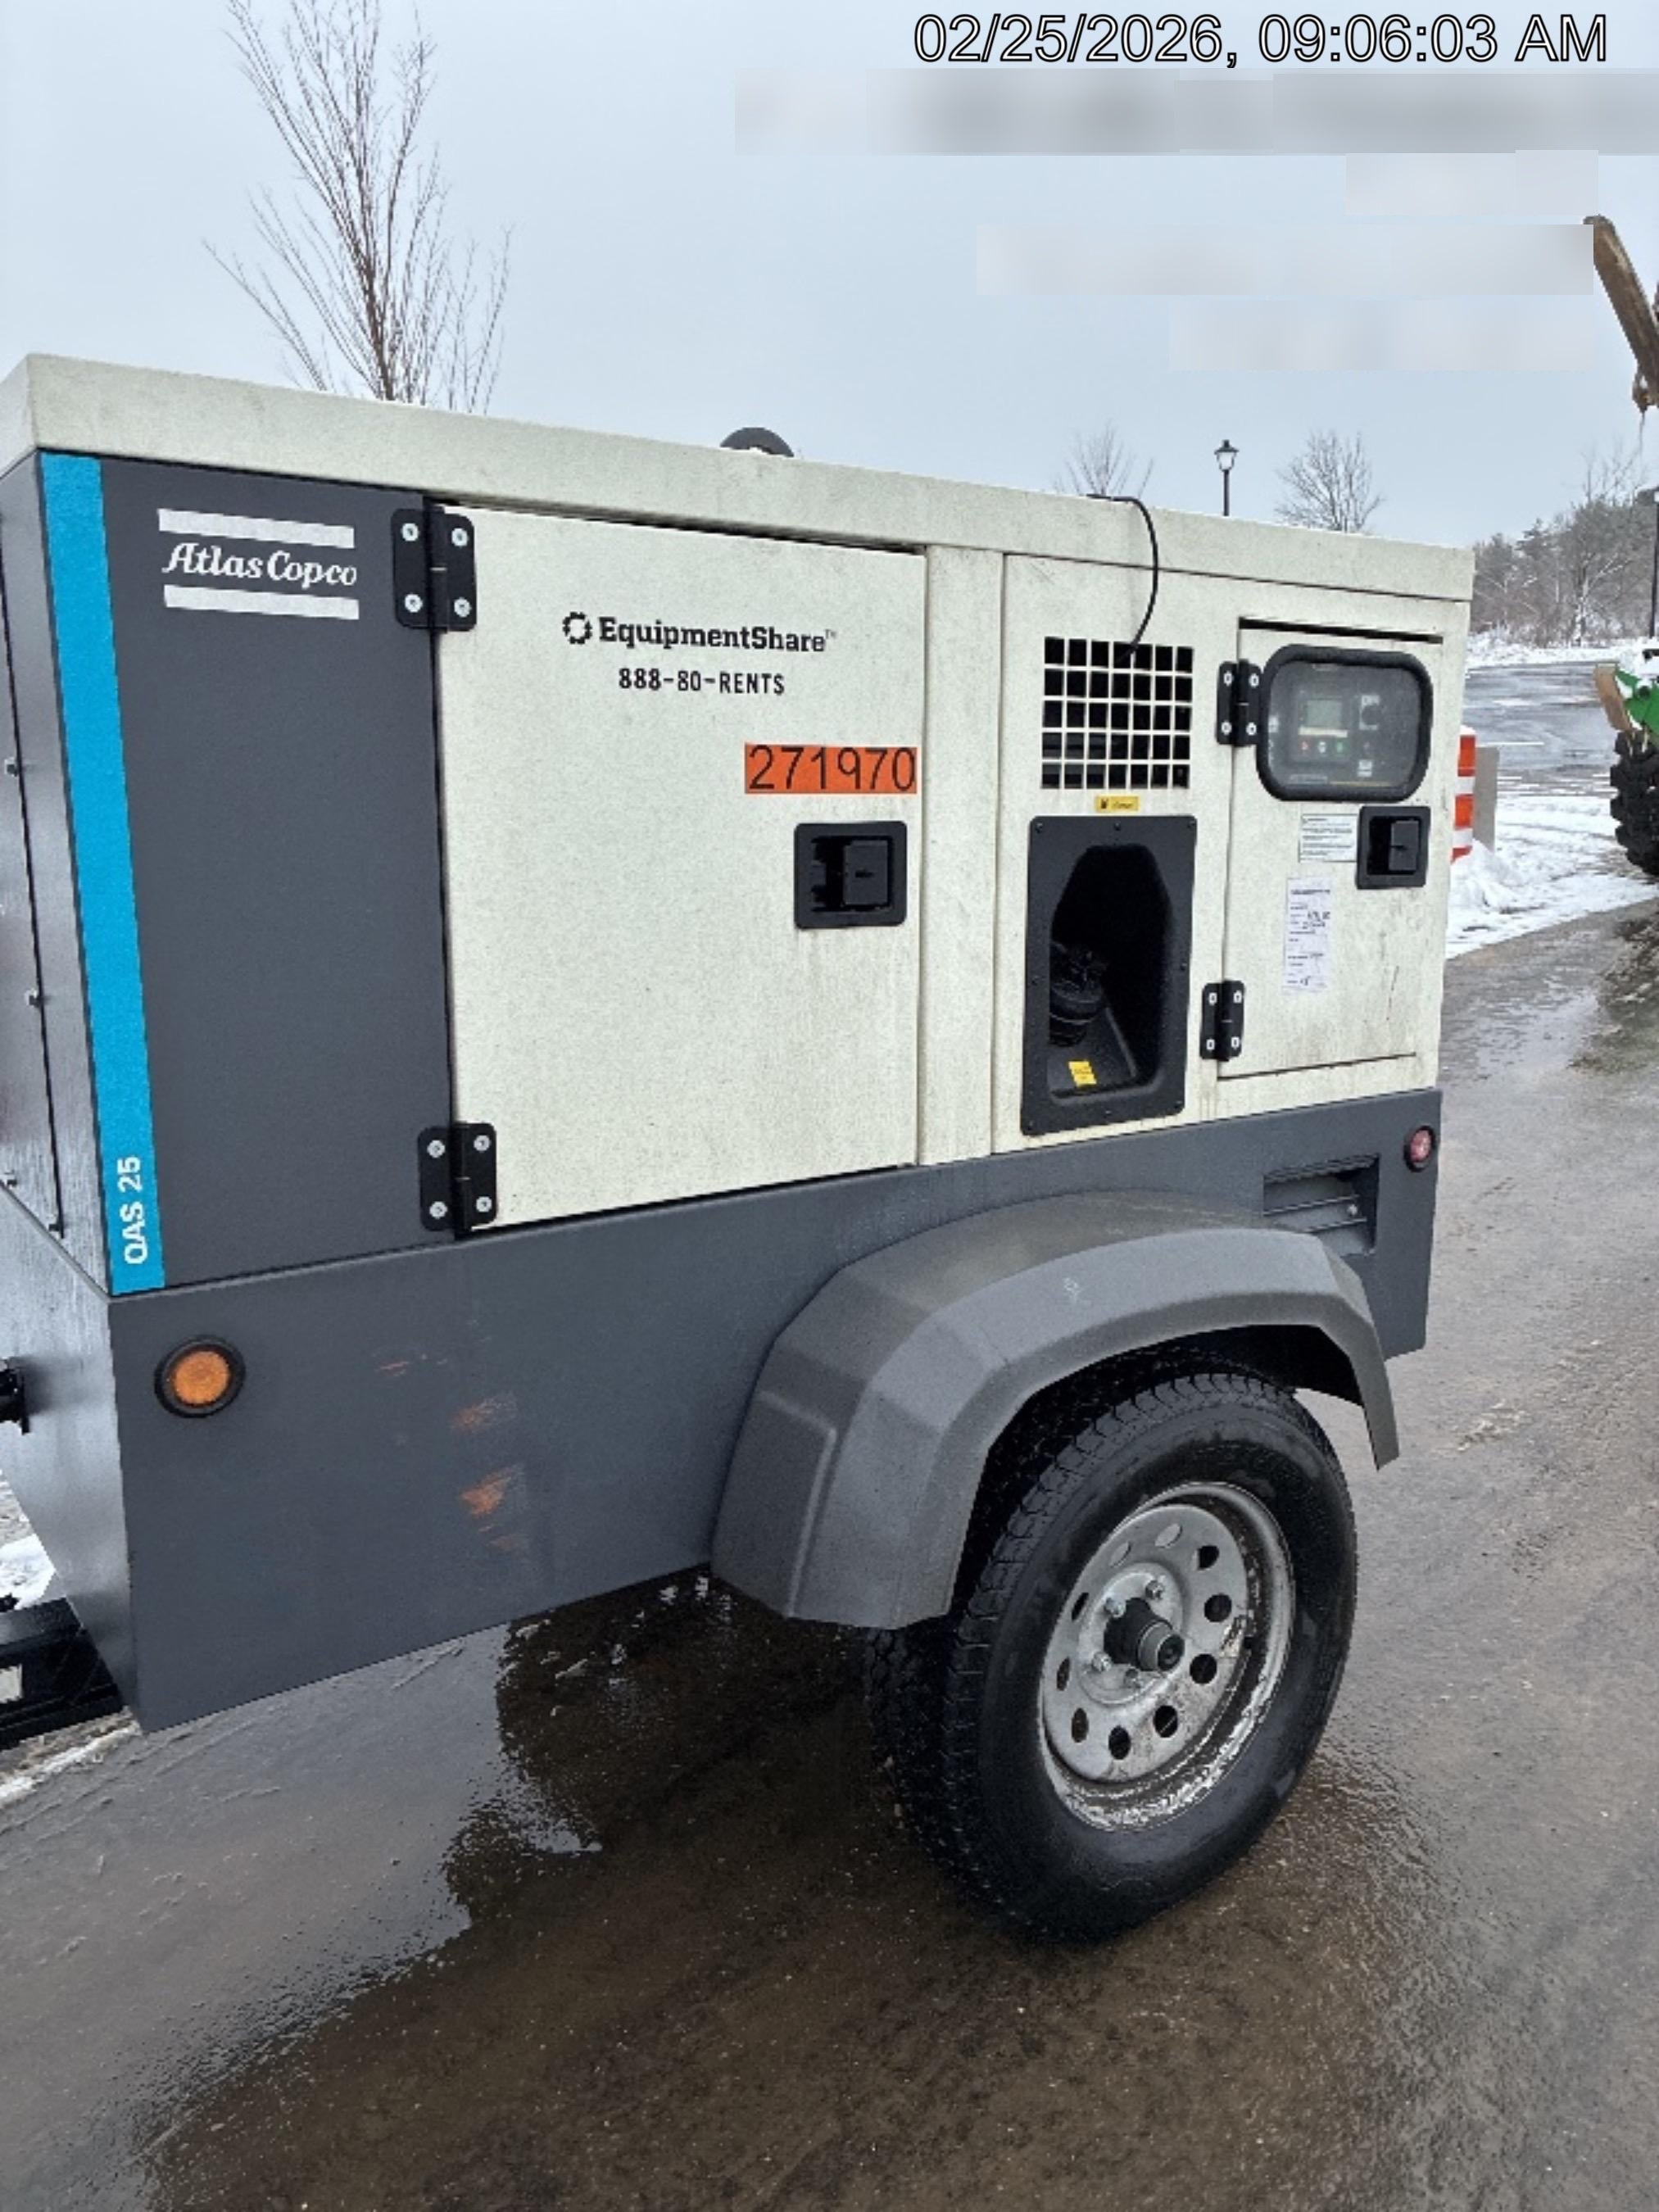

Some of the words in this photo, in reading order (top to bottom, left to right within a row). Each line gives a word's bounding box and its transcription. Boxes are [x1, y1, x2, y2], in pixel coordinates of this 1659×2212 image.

[163, 542, 264, 579] Atlas
[267, 551, 357, 590] Copco
[619, 668, 785, 696] 888-80-RENTS
[749, 745, 917, 792] 271970
[117, 1155, 143, 1193] 25
